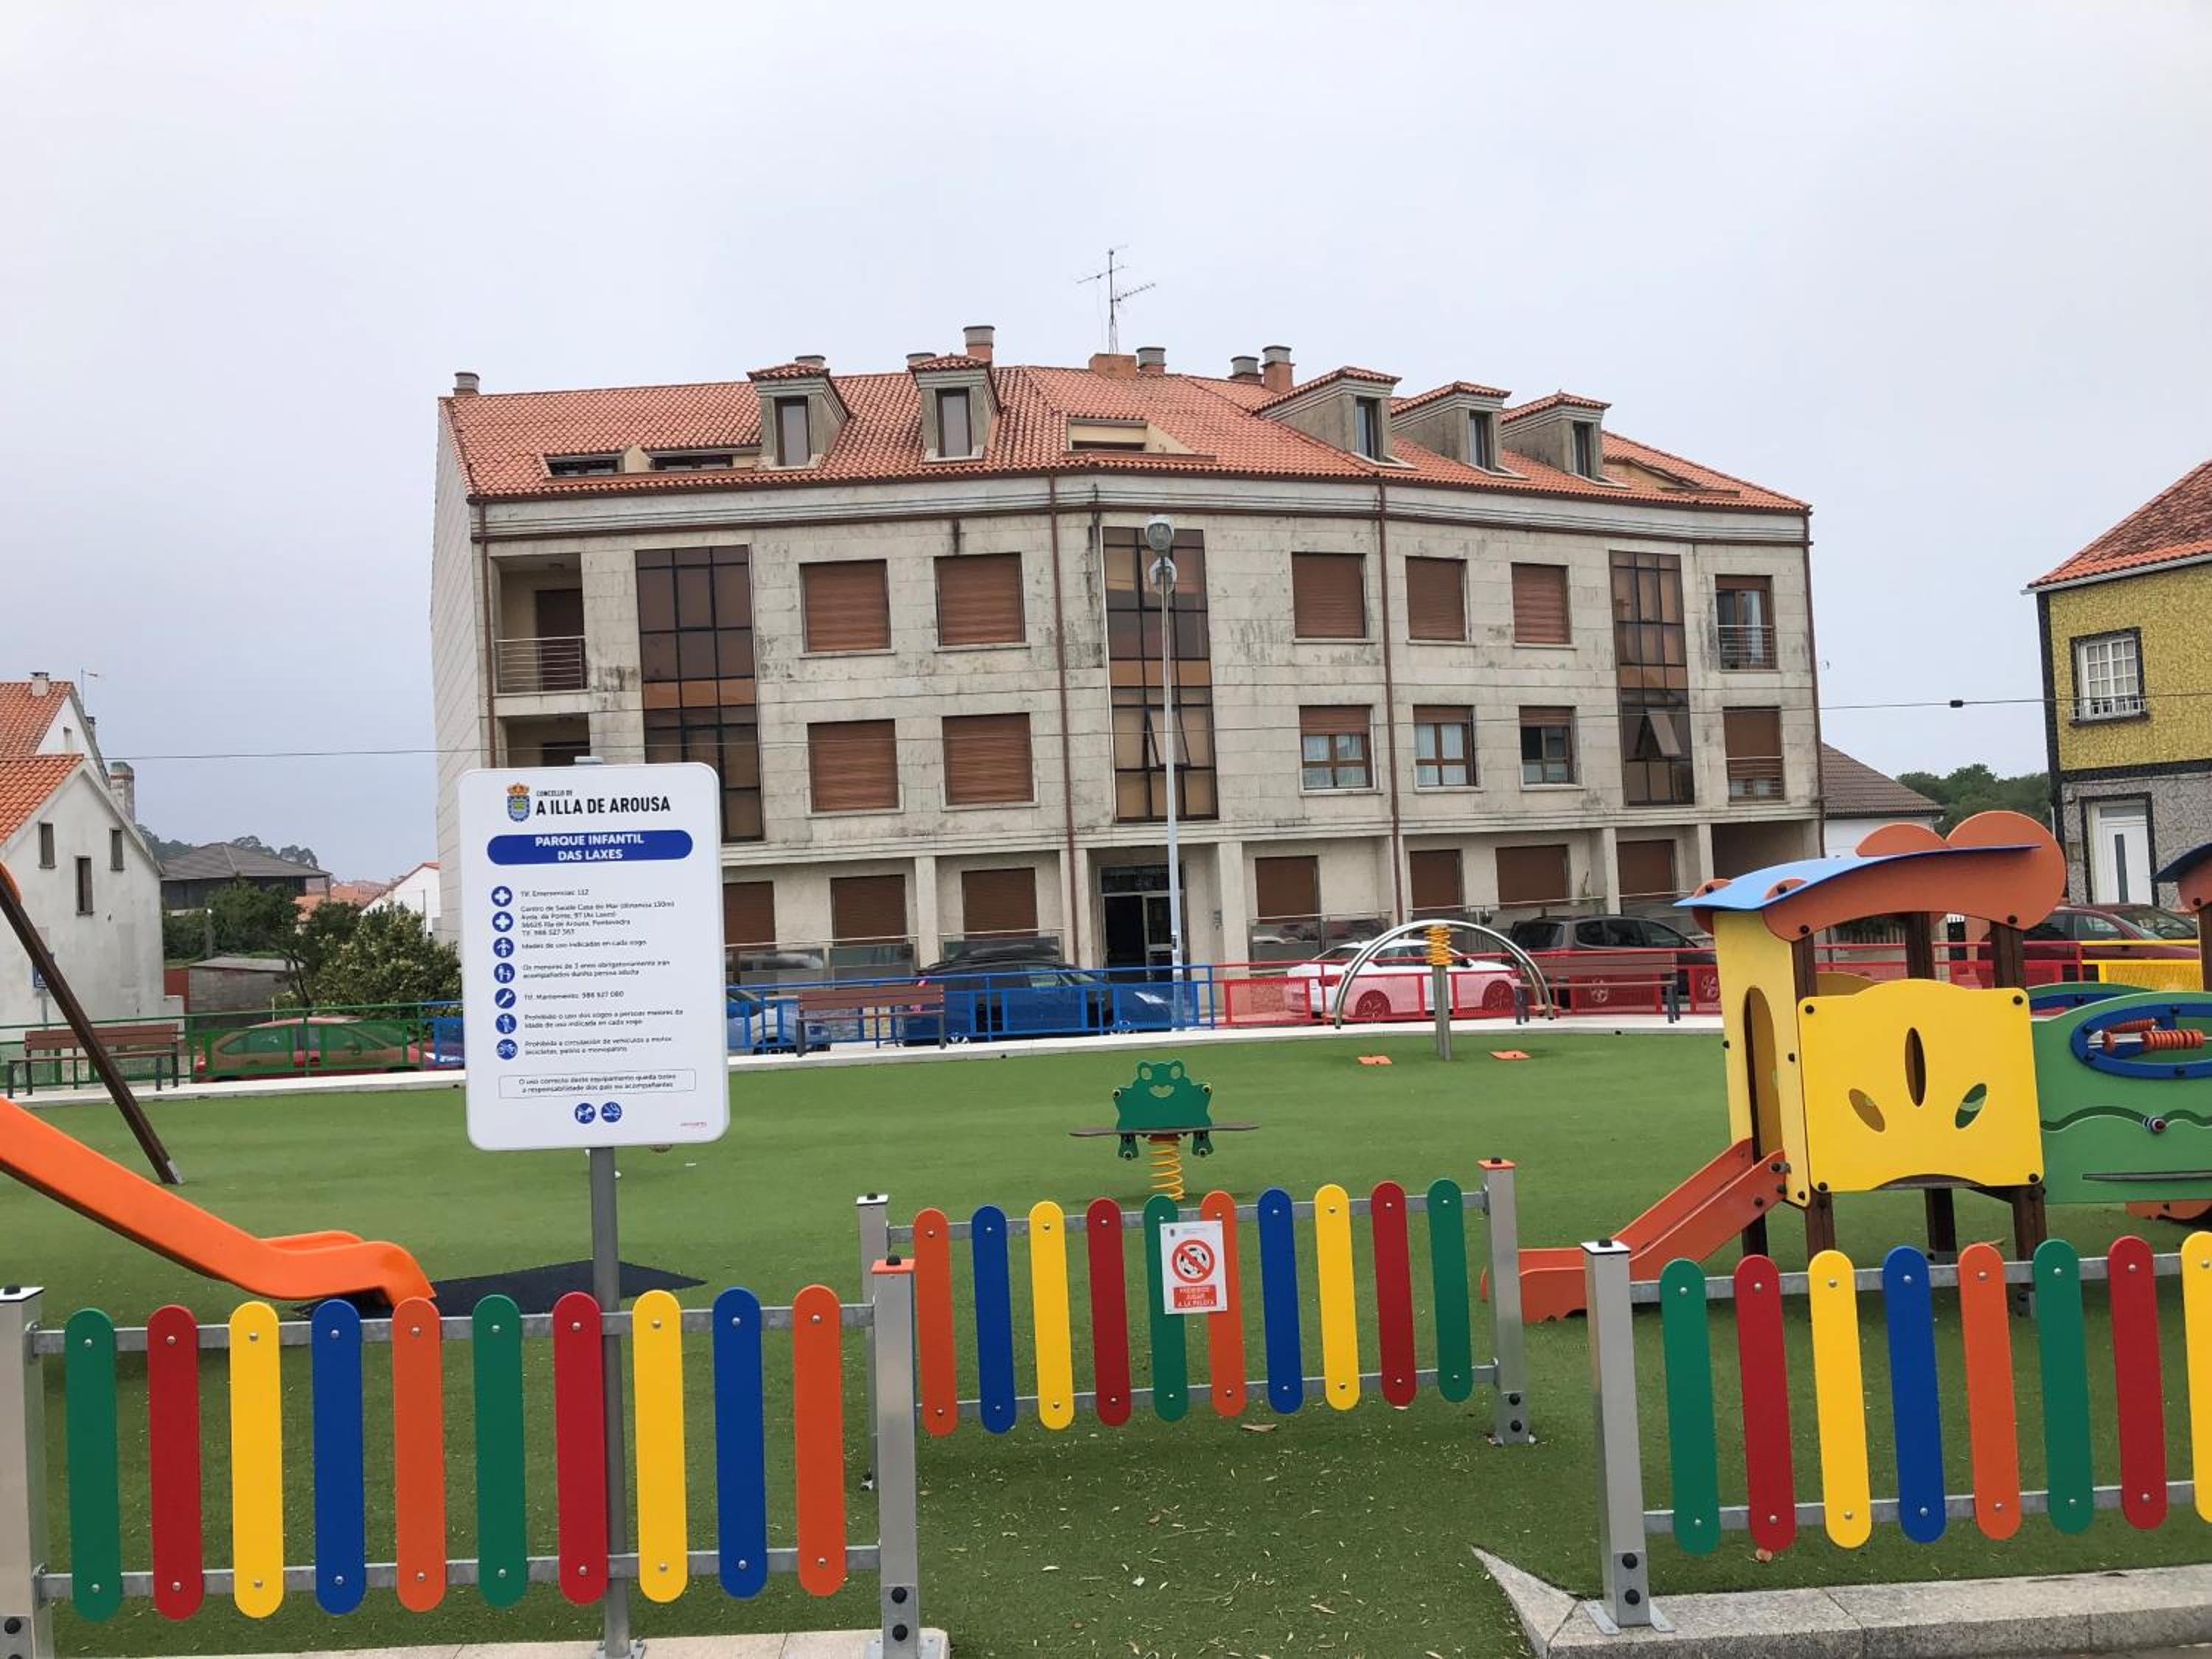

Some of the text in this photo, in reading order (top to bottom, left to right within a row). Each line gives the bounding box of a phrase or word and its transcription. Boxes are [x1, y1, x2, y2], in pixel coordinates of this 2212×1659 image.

[536, 796, 671, 815] A ILLA DE AROUSA
[535, 834, 645, 847] PARQUE INFANTIL
[557, 849, 623, 861] DAS LAXES
